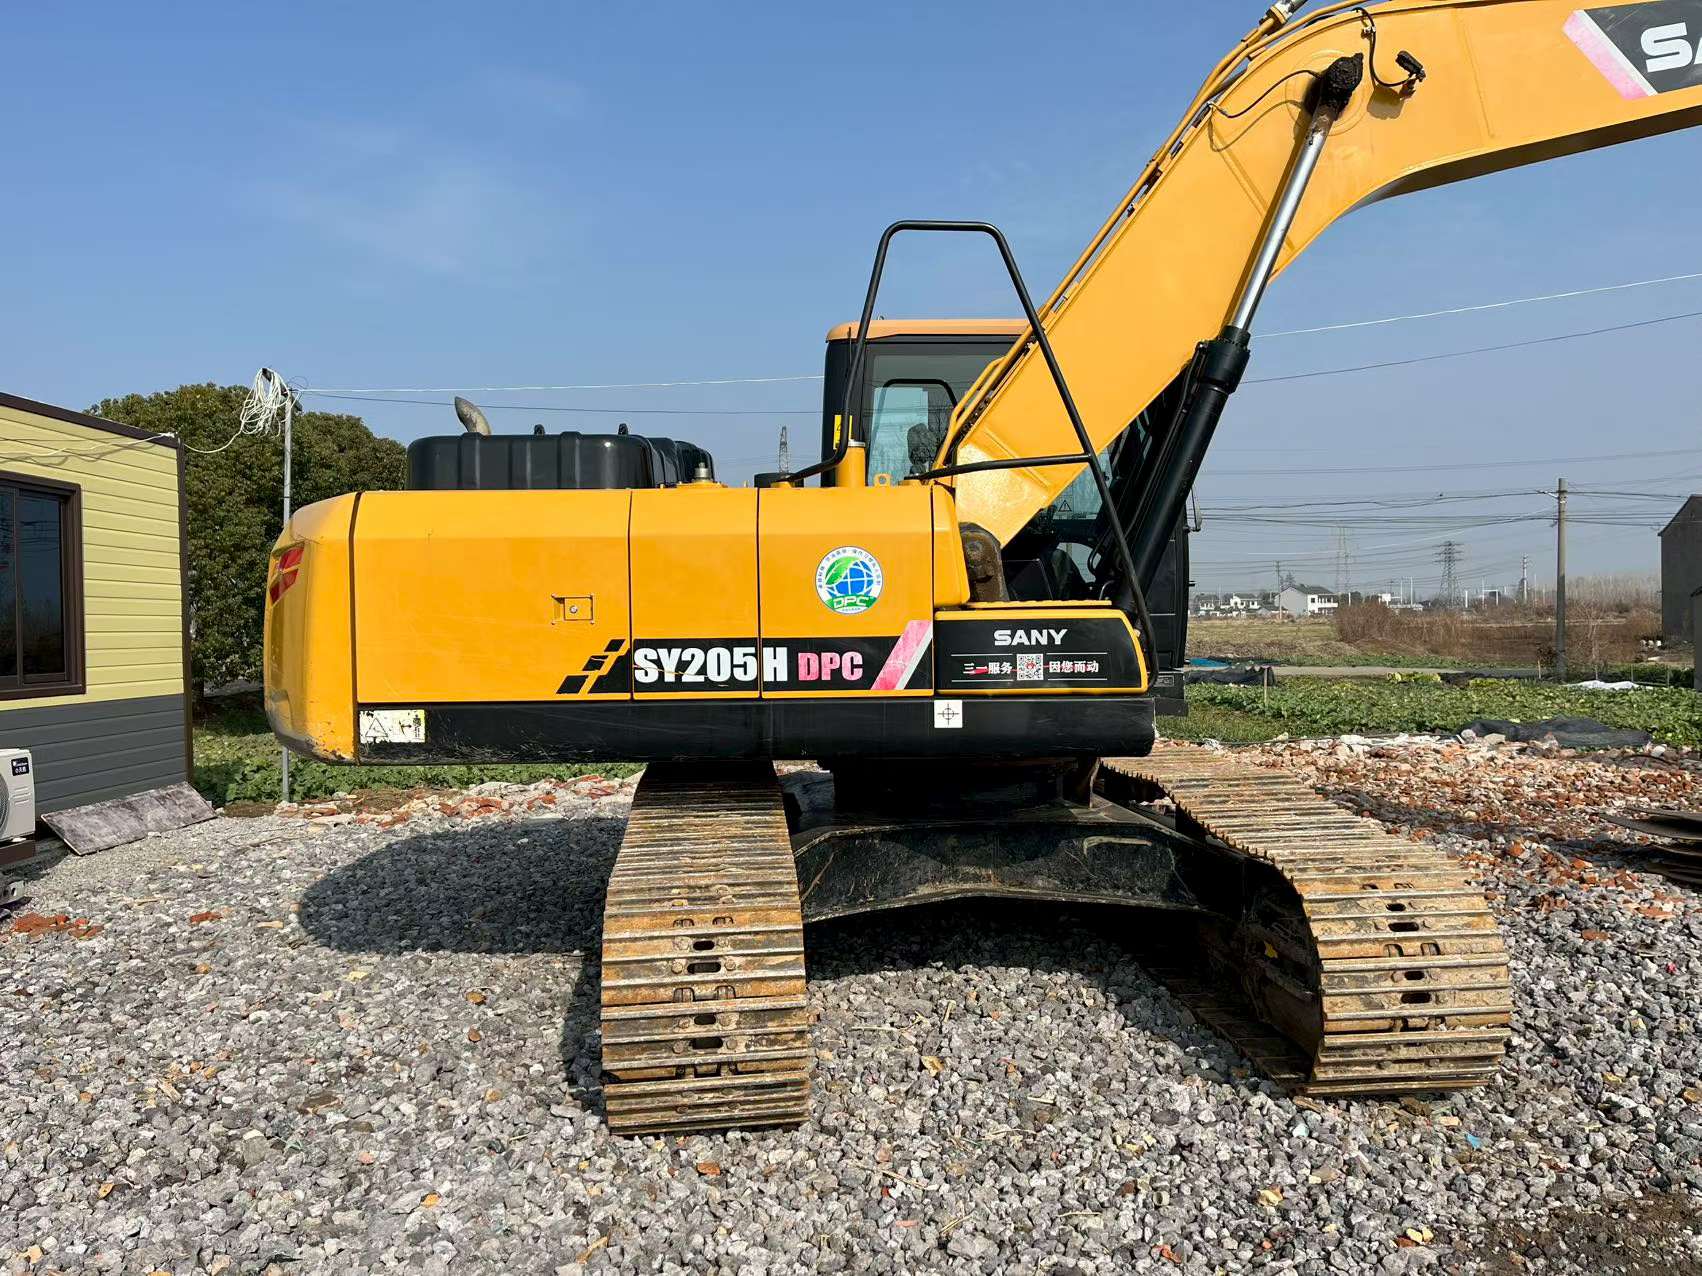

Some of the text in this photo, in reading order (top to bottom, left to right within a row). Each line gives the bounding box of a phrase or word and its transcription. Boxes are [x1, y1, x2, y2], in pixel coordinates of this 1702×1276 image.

[1641, 22, 1702, 72] S
[833, 596, 869, 609] DPC
[993, 629, 1068, 646] SANY
[633, 647, 864, 683] SY205H DPC
[963, 660, 1099, 675] 三一服务 因您而动
